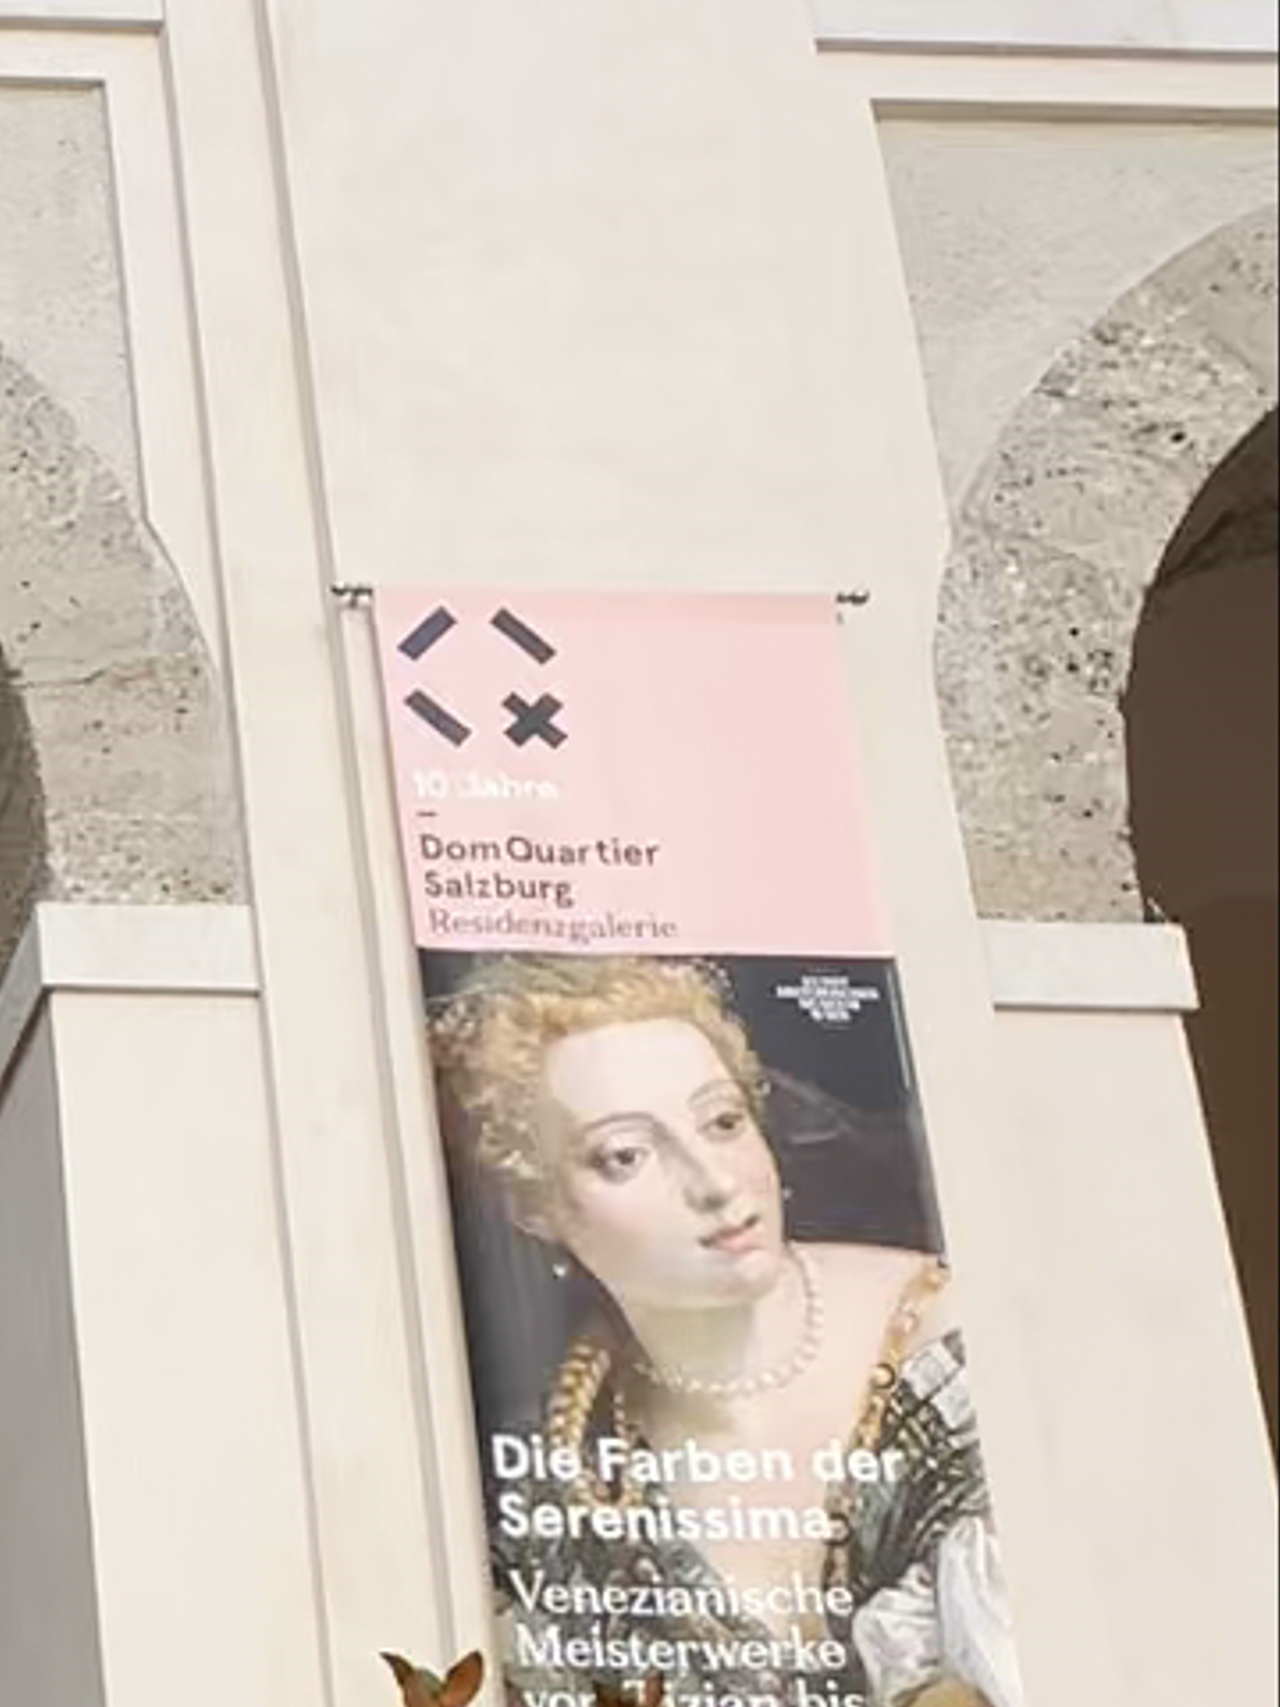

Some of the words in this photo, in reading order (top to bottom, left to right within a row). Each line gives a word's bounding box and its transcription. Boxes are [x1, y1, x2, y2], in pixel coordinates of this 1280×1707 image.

[424, 869, 576, 910] Salzburg
[427, 907, 679, 946] Residenzgalerie
[491, 1434, 582, 1481] Die
[597, 1437, 794, 1484] Farben
[811, 1438, 904, 1486] der
[497, 1494, 834, 1542] Serenissima
[508, 1567, 855, 1618] Venezianische
[514, 1623, 848, 1671] Meisterwerke
